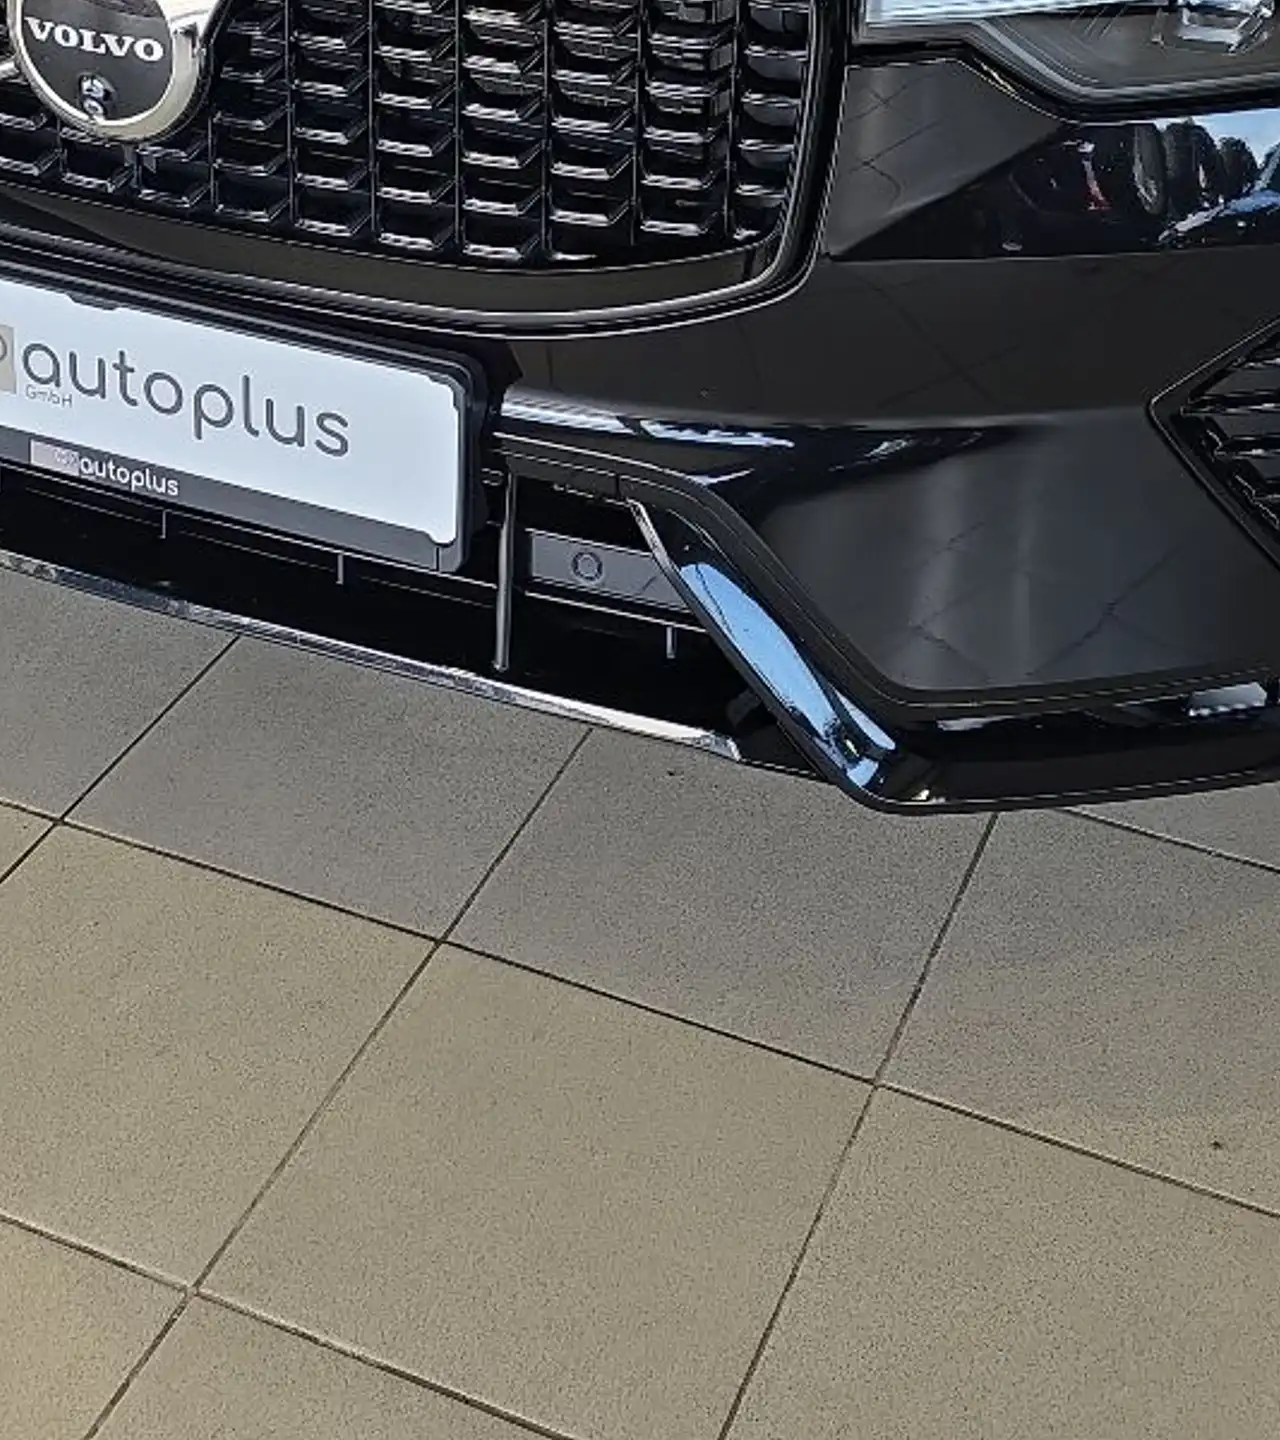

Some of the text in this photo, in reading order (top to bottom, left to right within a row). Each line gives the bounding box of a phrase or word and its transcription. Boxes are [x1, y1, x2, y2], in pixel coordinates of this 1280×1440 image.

[23, 16, 165, 63] VOLVO
[22, 342, 351, 459] autoplus
[79, 455, 179, 497] autoplus
